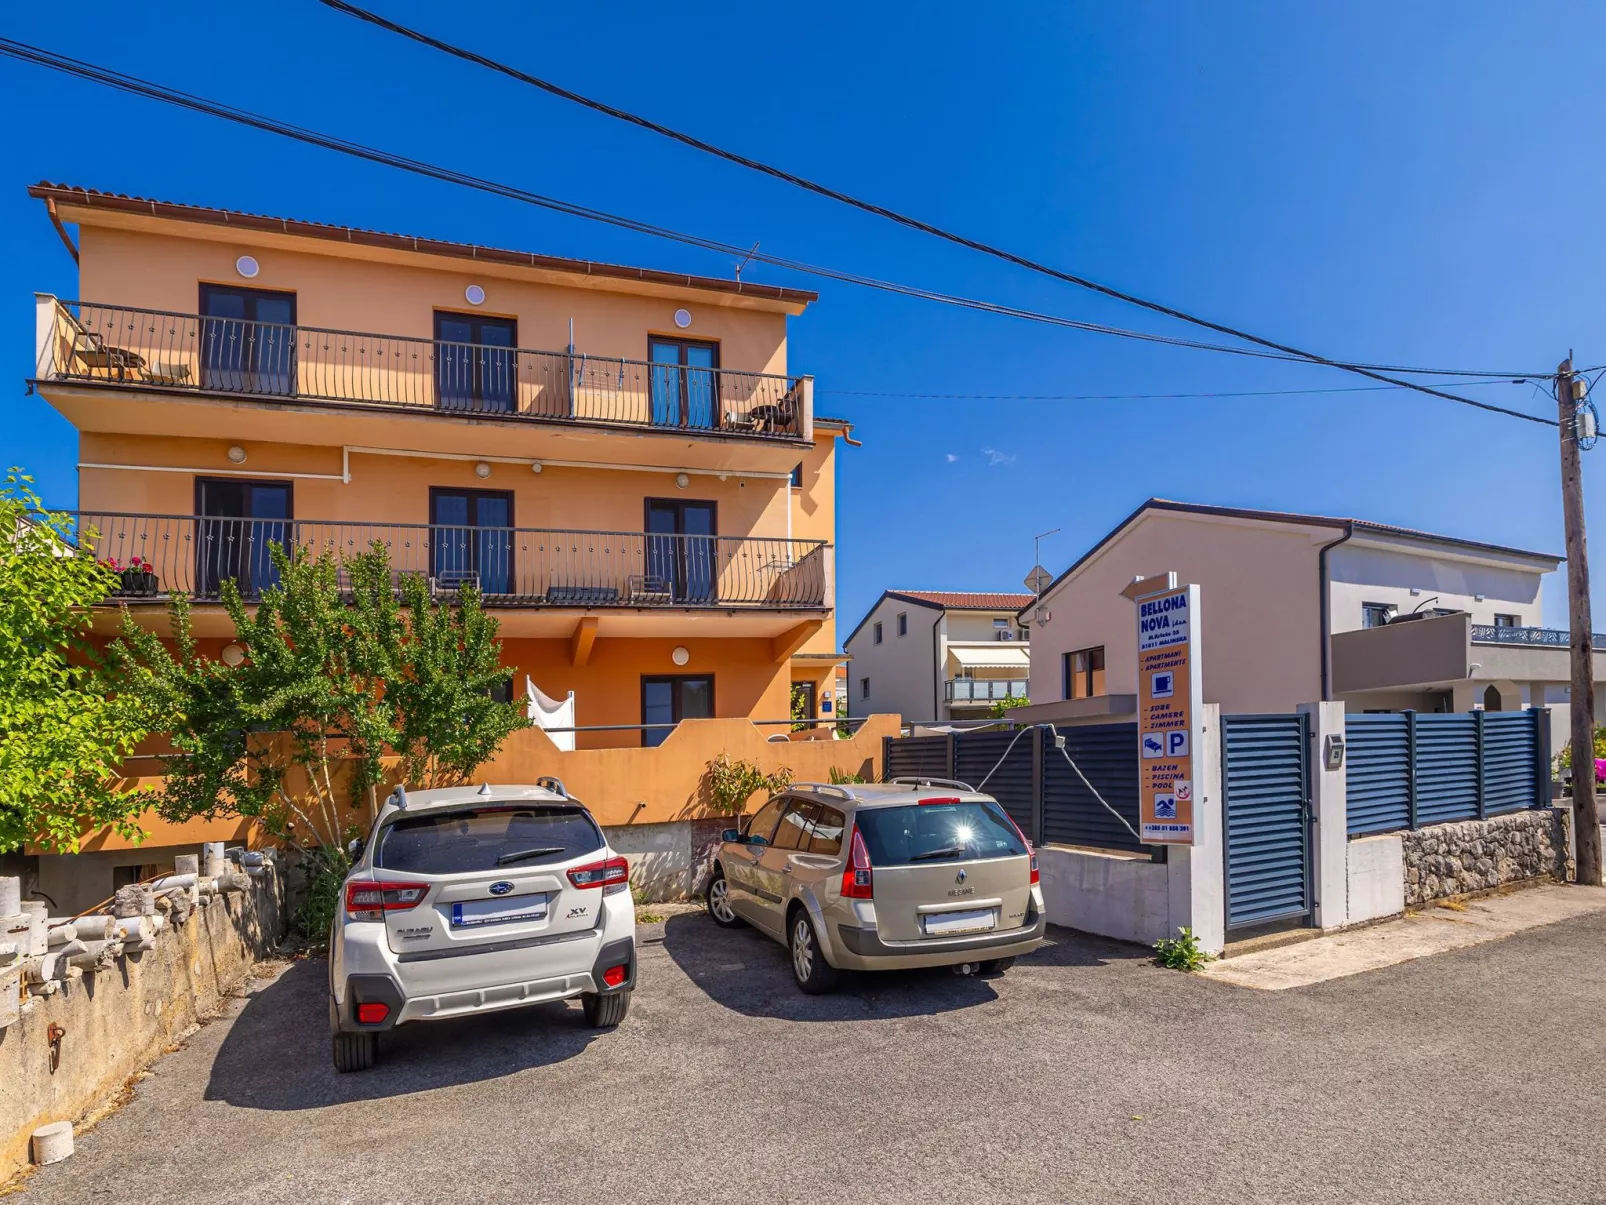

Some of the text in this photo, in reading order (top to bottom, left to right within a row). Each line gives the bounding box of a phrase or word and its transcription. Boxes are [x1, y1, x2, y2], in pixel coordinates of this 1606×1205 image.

[1141, 594, 1187, 617] BELLONA
[1141, 615, 1170, 633] NOVA
[1159, 635, 1187, 646] MALINSKA
[1145, 650, 1182, 663] APARTMANI
[1145, 658, 1187, 671] APARTMENTS
[1150, 703, 1171, 712] SOBE
[1150, 710, 1185, 720] CAMERE
[1150, 719, 1185, 729] ZIMMER
[1170, 733, 1184, 754] P
[1151, 764, 1178, 772] BAZEN
[1151, 772, 1185, 780] PISCINA
[570, 907, 587, 915] XV
